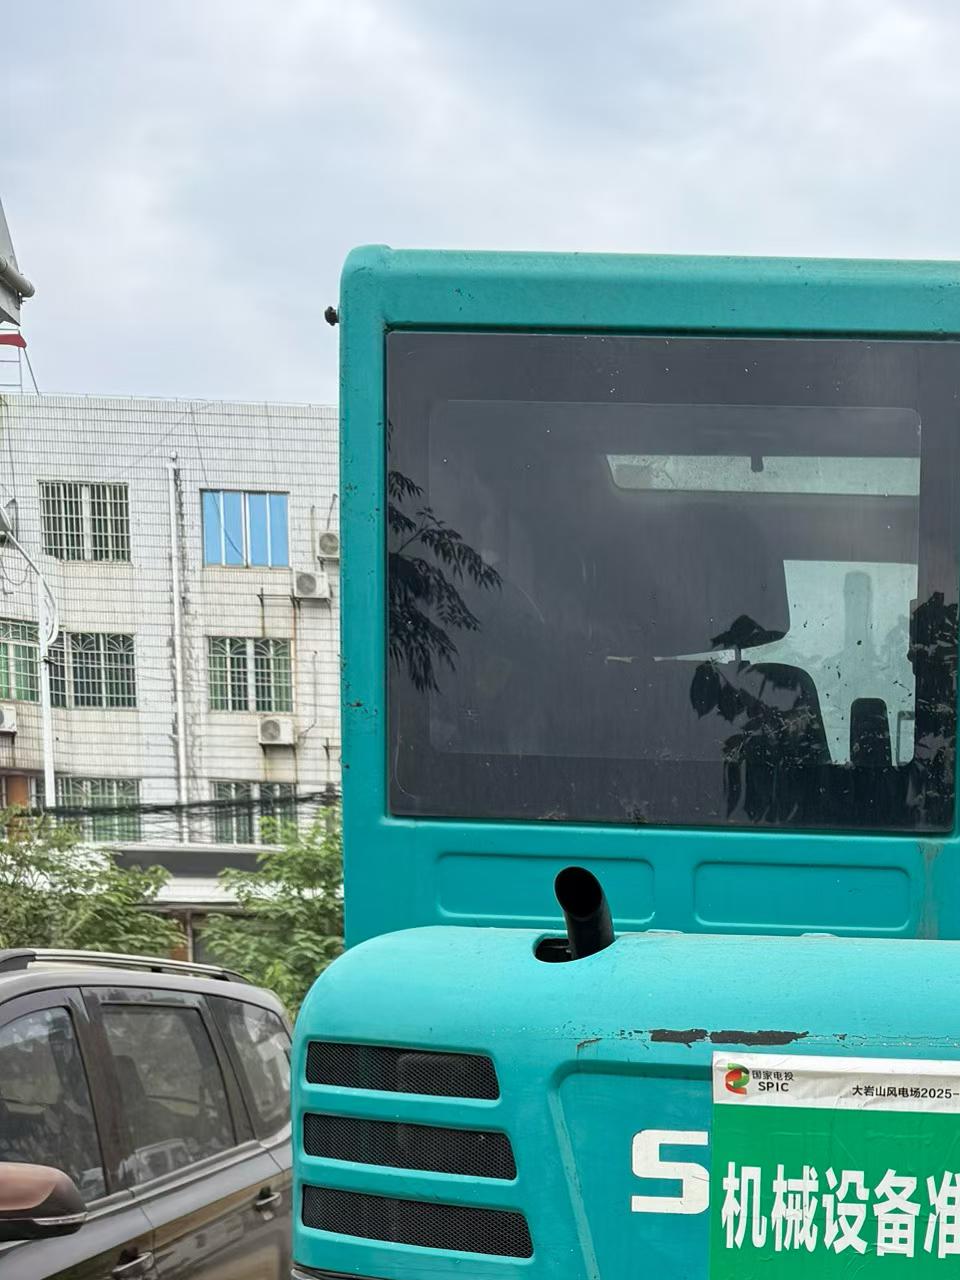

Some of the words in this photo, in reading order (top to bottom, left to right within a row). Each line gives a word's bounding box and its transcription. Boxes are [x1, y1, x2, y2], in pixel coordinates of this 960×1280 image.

[752, 1069, 794, 1081] 国家电投
[758, 1081, 789, 1092] SPIC
